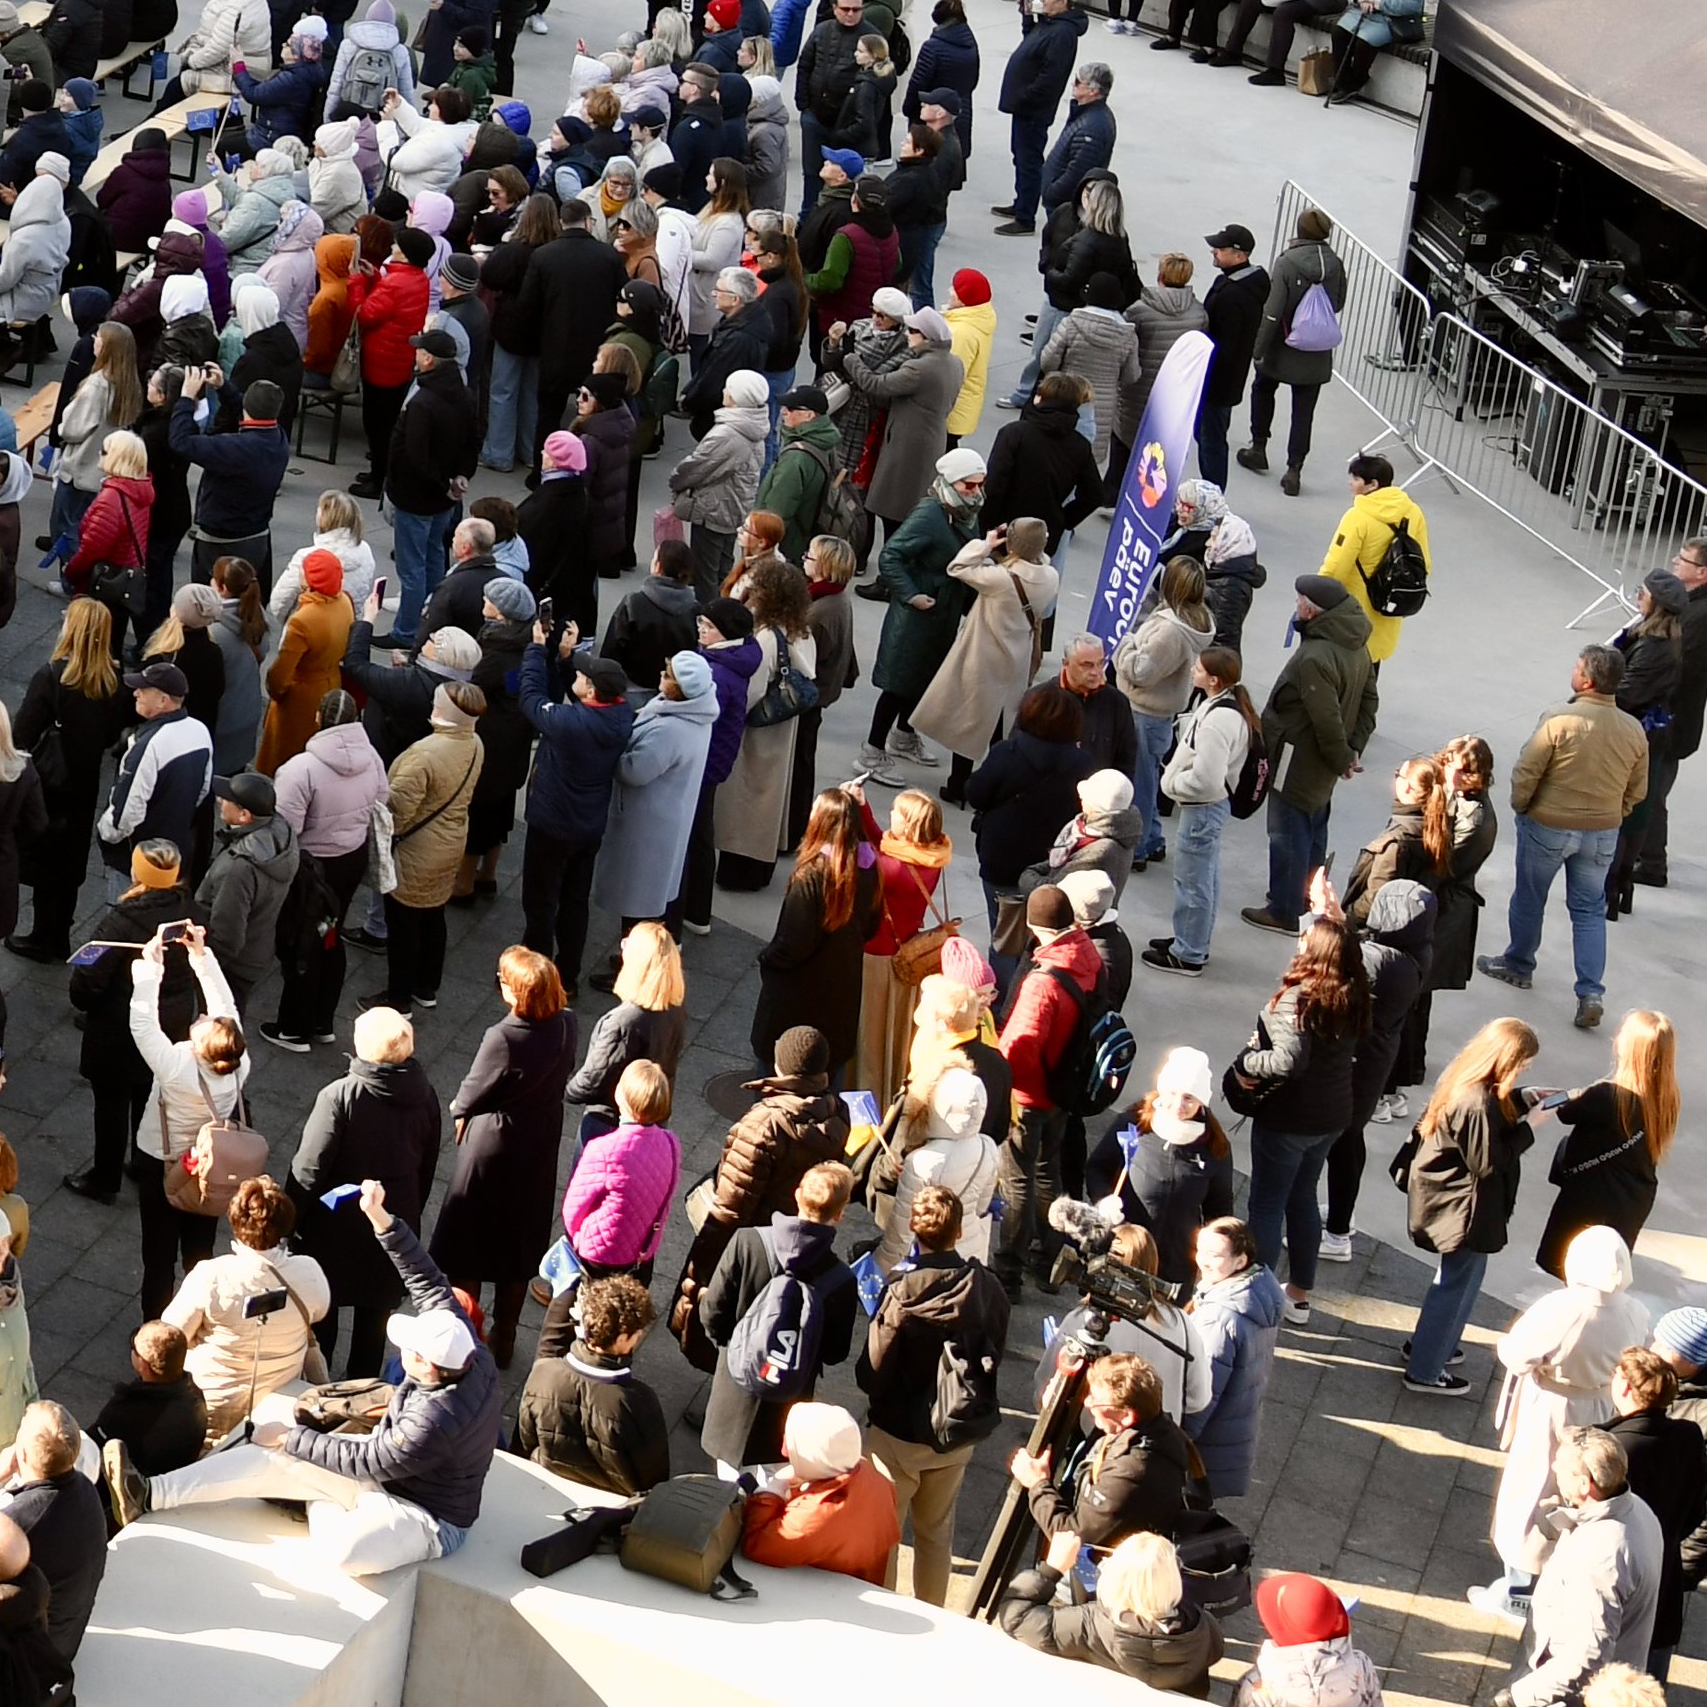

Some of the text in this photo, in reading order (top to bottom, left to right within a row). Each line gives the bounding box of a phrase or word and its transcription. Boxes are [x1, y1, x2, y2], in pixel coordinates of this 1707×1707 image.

[1103, 517, 1134, 612] päev
[1106, 538, 1151, 654] Euroo
[1599, 1146, 1623, 1162] HUGO
[1622, 1129, 1644, 1150] HUGO
[759, 1330, 798, 1384] FILA
